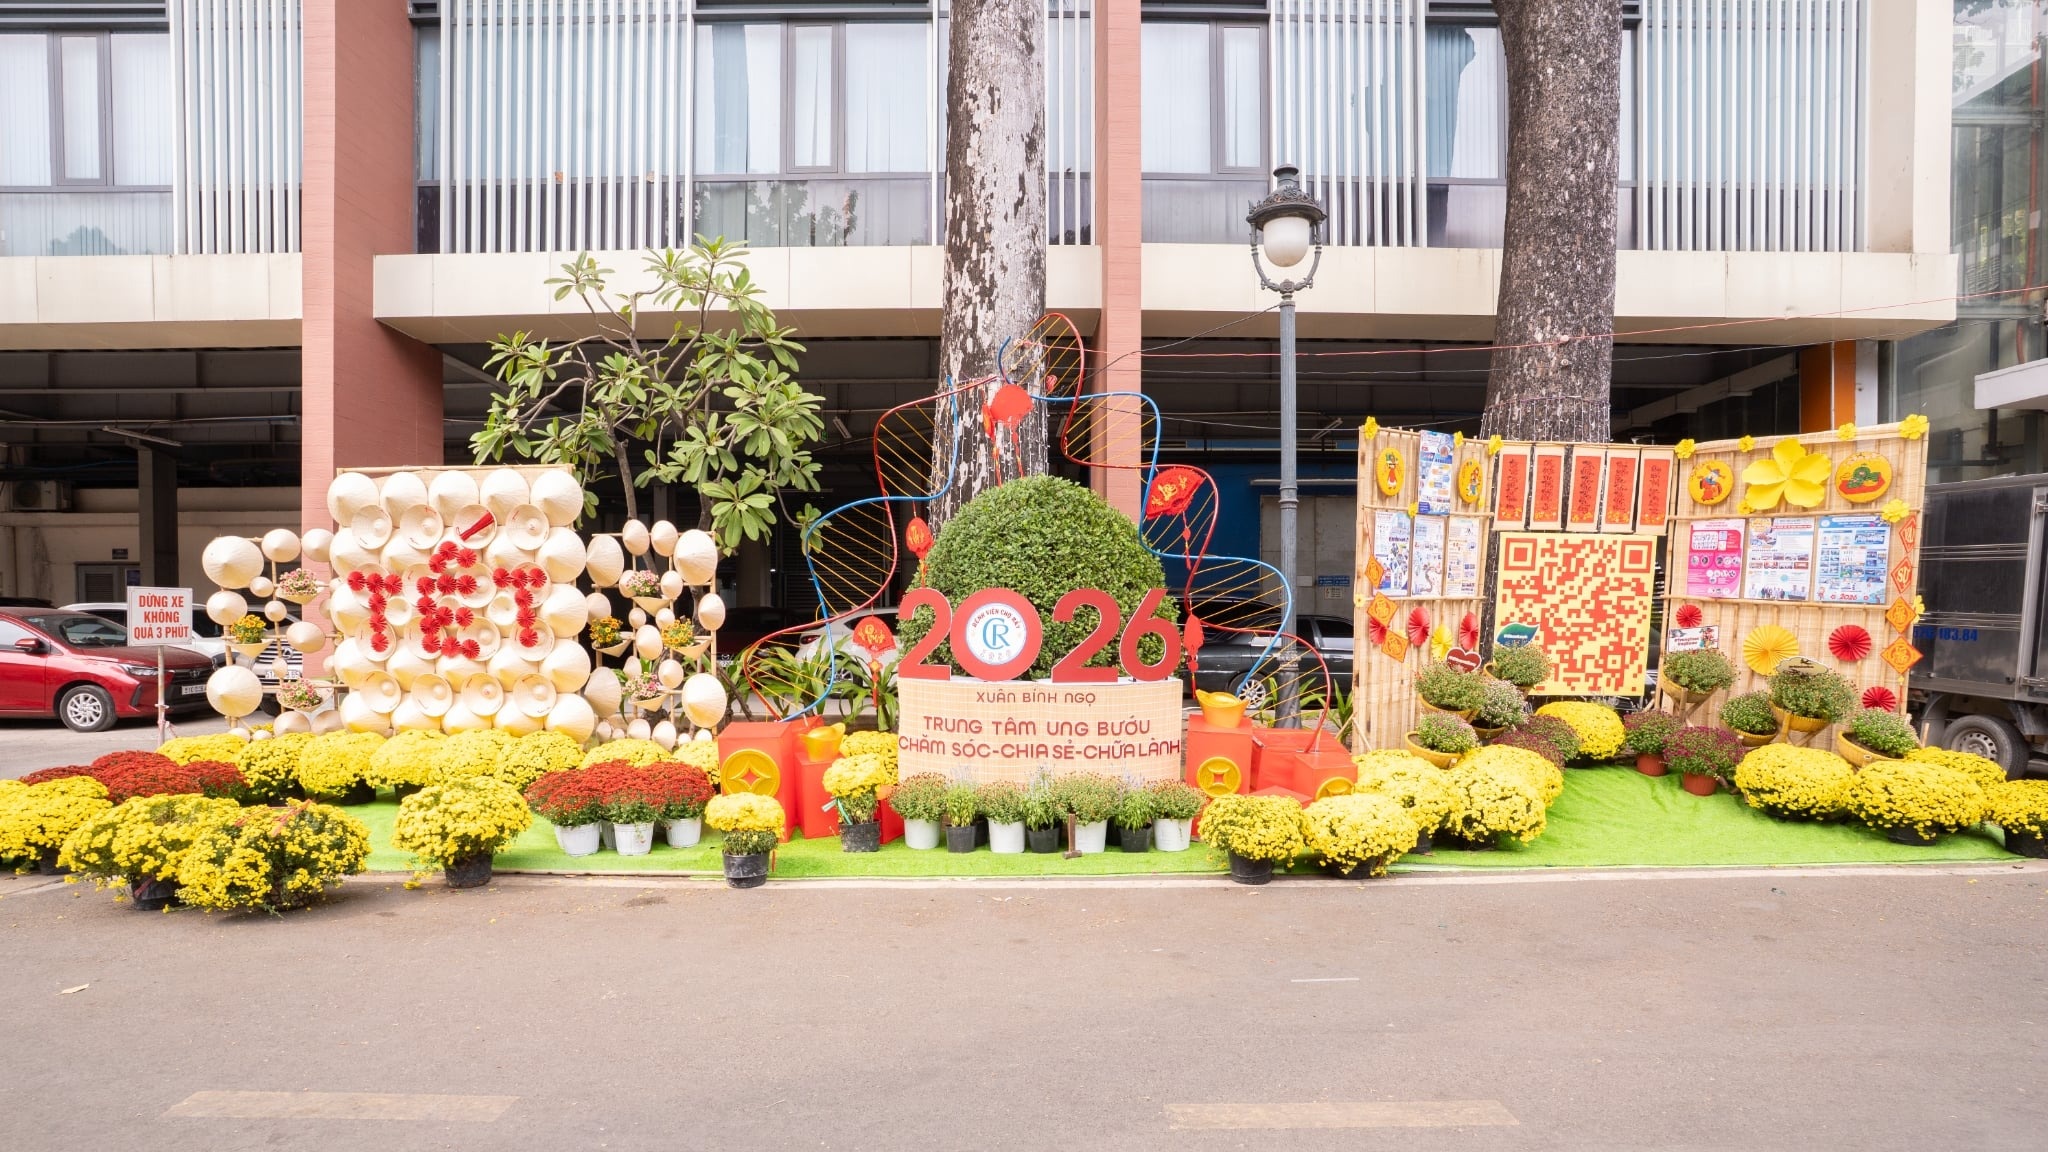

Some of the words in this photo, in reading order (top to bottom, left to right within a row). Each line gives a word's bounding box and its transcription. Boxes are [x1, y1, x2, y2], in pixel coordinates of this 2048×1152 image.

[138, 592, 168, 608] DỪNG
[171, 595, 184, 608] XE
[143, 608, 180, 623] KHÔNG
[133, 624, 154, 640] QUÁ
[156, 626, 162, 639] 3
[165, 624, 189, 638] PHÚT
[898, 587, 1182, 683] 2026
[976, 688, 1016, 703] XUÂN
[1022, 688, 1058, 703] BÍNH
[1064, 692, 1096, 707] NGỌ
[923, 715, 983, 734] TRUNG
[992, 717, 1037, 736] TÂM
[1046, 721, 1089, 736] UNG
[1097, 715, 1150, 736] BƯỚU
[898, 733, 946, 755] CHĂM
[1139, 737, 1180, 757] LÀNH
